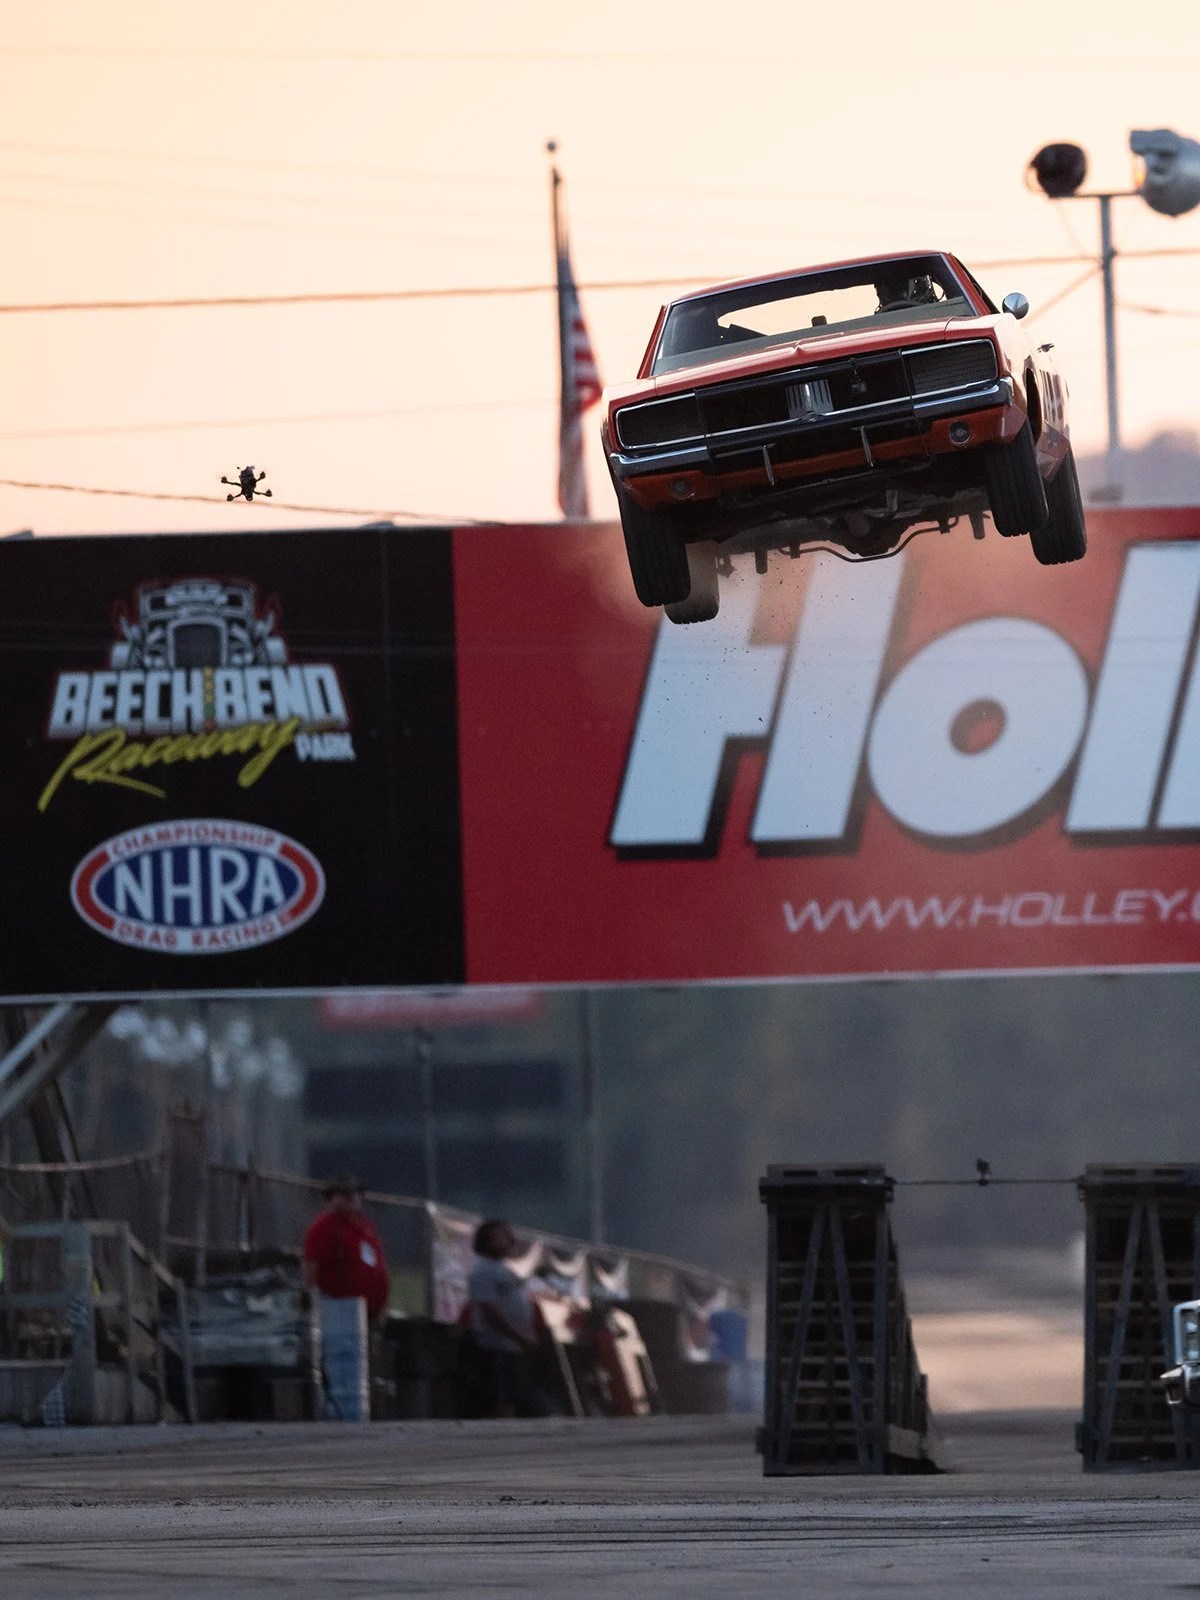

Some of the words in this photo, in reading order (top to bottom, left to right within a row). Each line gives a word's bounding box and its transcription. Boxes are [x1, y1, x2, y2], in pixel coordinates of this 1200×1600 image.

[49, 667, 204, 738] BEECH
[213, 664, 350, 732] BEND
[37, 717, 301, 812] Raceway
[296, 732, 356, 762] PARK
[111, 823, 277, 856] CHAMPIONSHIP
[113, 847, 286, 925] NHRA
[117, 920, 178, 946] DRAG
[191, 920, 275, 946] RACING
